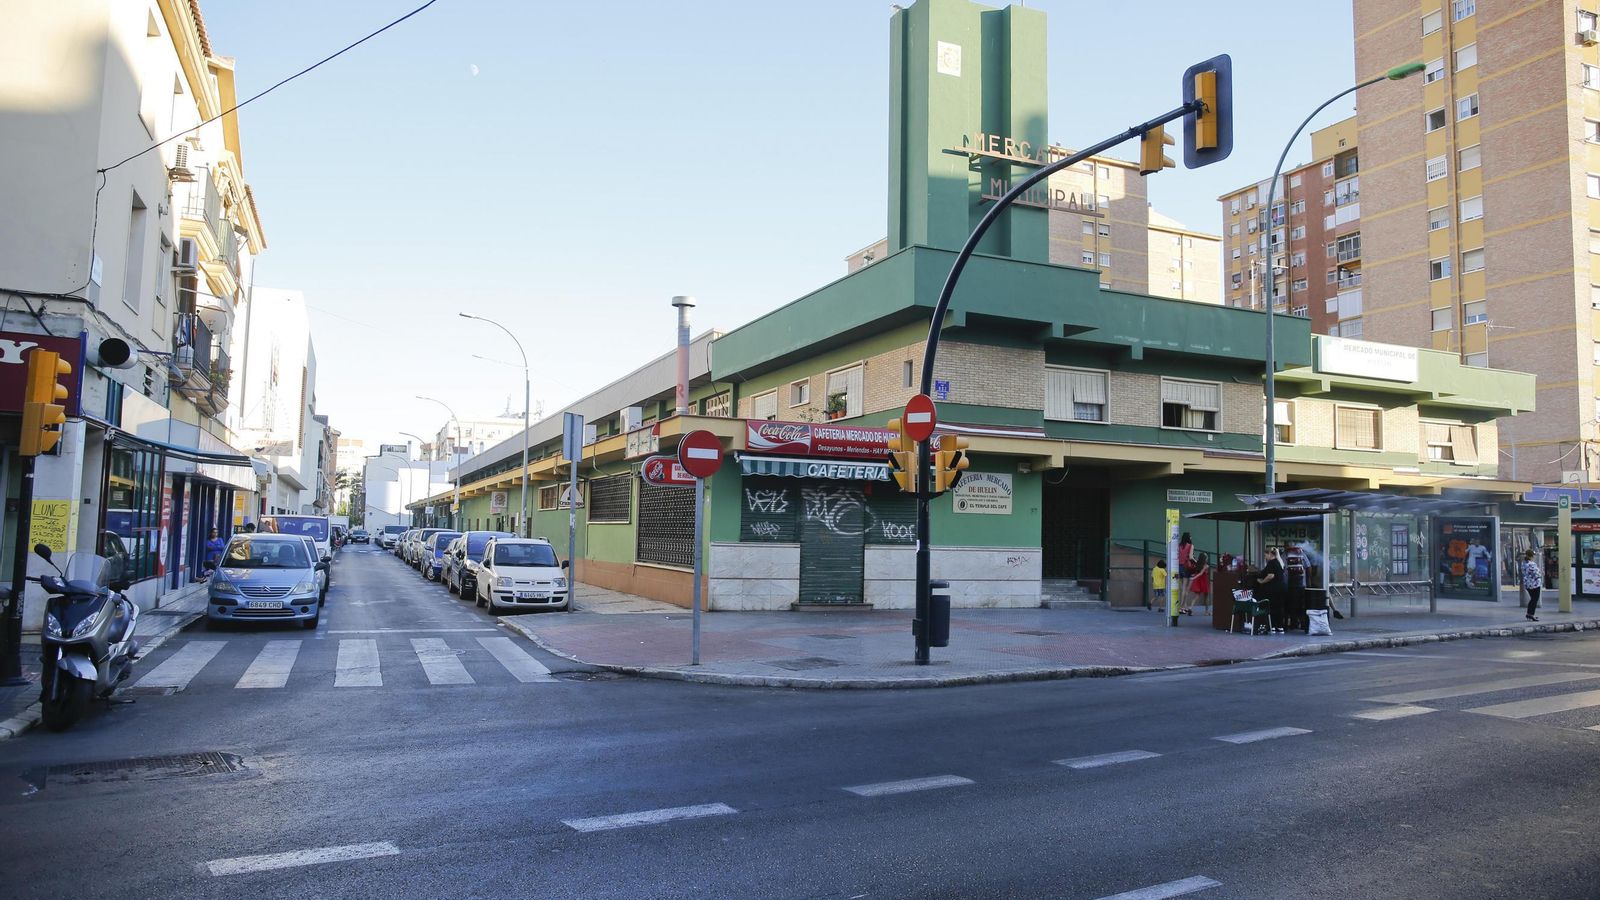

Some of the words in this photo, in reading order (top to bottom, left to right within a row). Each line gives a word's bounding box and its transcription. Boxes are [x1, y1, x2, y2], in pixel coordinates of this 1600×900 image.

[757, 422, 803, 442] Coca-Cola
[814, 427, 846, 440] CAFETERIA
[846, 429, 874, 442] MERCADO
[874, 431, 883, 443] DE
[817, 444, 843, 452] Desayunos
[807, 464, 889, 480] CAFETERIA
[954, 474, 982, 493] CAFETERIA
[987, 474, 1012, 495] MERCADO
